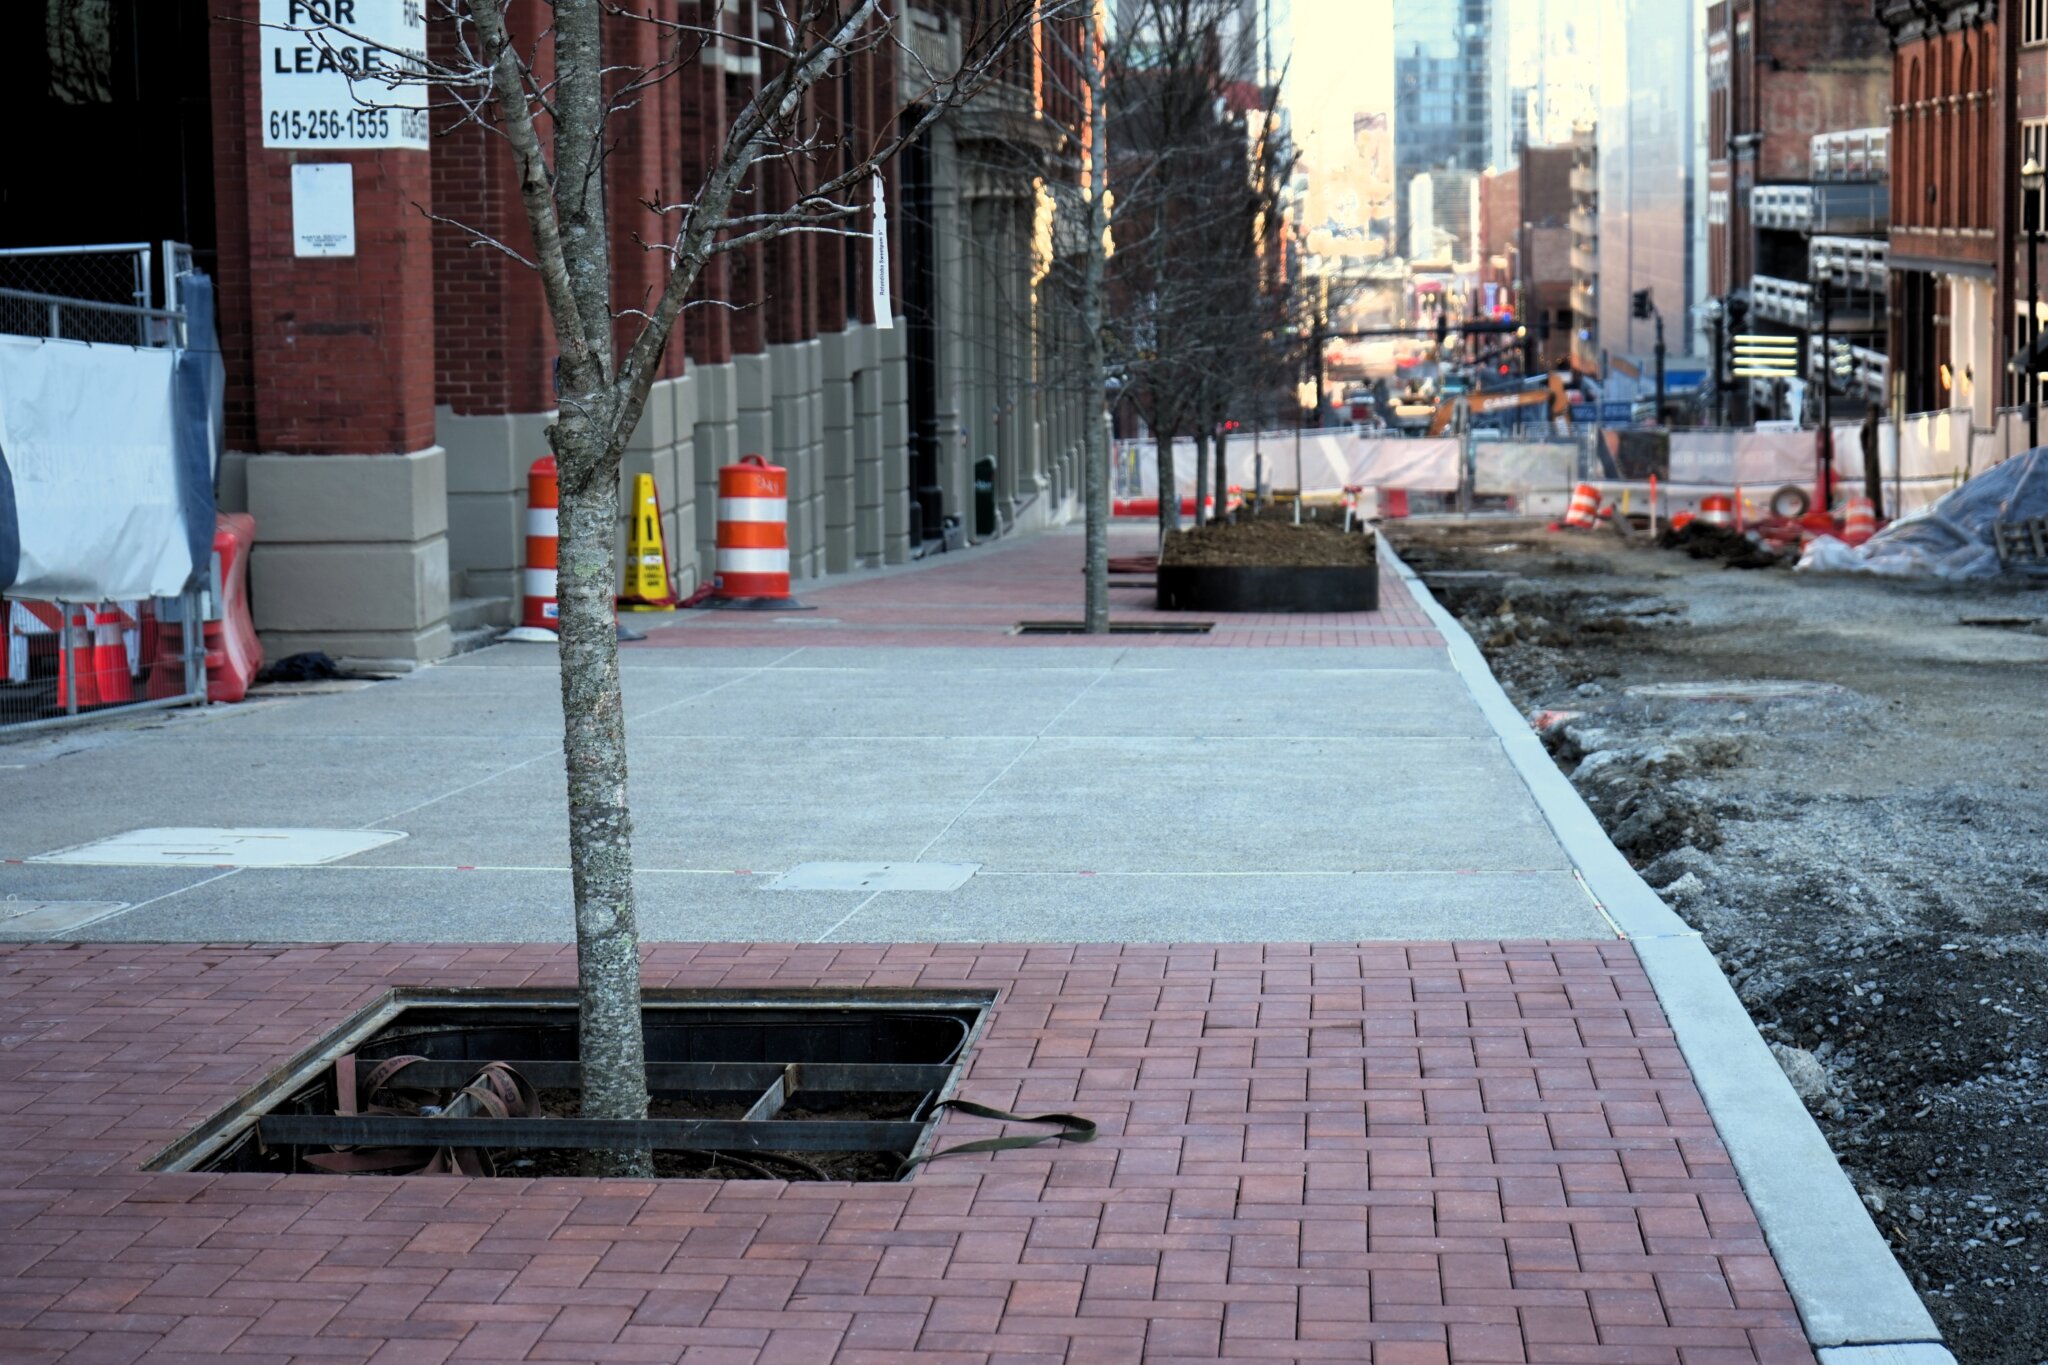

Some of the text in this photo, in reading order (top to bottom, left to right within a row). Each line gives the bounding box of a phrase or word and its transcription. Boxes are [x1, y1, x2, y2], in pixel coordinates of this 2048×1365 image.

[289, 0, 356, 25] FOR
[403, 1, 420, 29] FOR
[274, 47, 383, 74] LEASE
[271, 110, 389, 139] 615-256-1555
